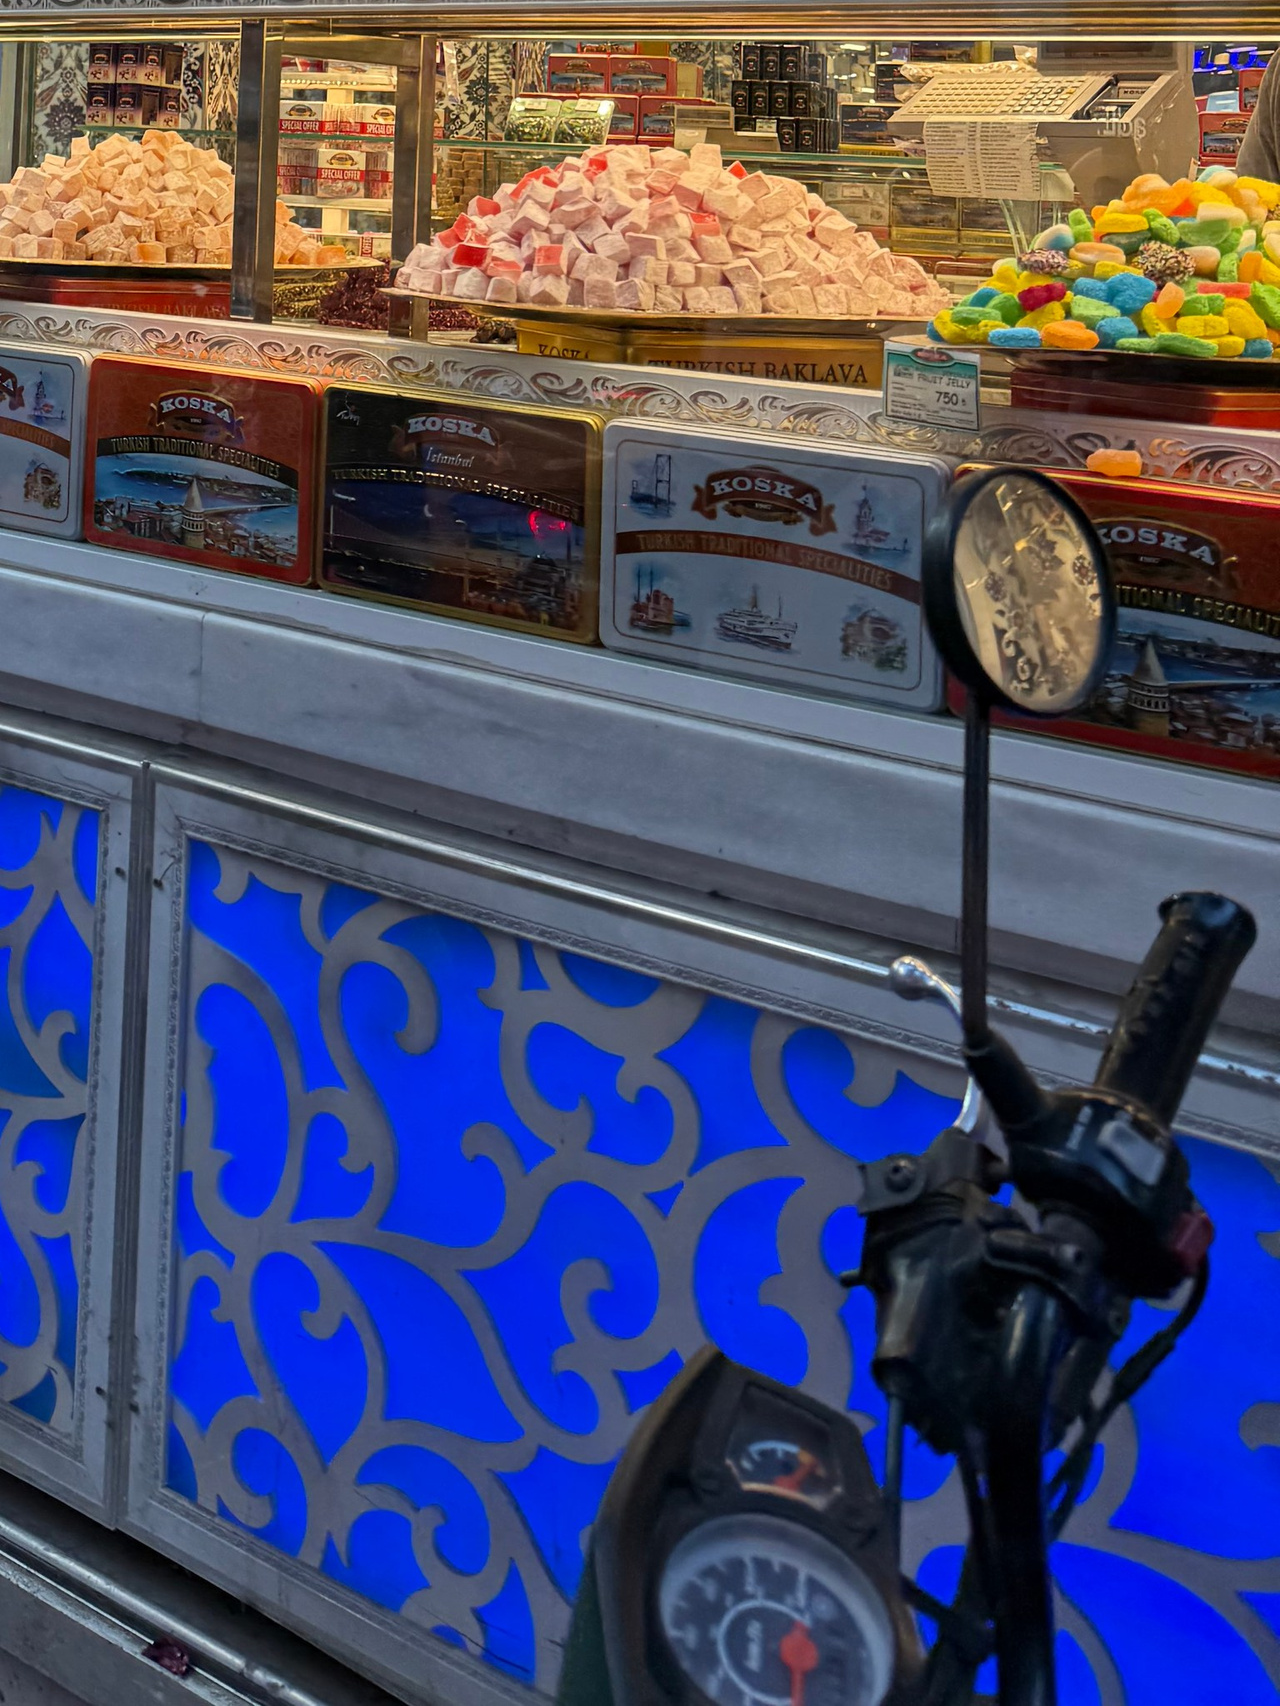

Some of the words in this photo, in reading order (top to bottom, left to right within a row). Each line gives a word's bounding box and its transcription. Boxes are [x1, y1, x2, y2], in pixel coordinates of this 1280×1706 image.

[281, 121, 302, 130] SPECIAL
[302, 122, 320, 131] OFFER
[321, 169, 343, 179] SPECIAL
[343, 170, 360, 179] OFFER
[766, 361, 868, 384] BAKLAVA
[946, 378, 971, 389] JELLY
[160, 396, 231, 423] KOSKA
[935, 391, 958, 406] 750
[408, 416, 496, 446] KOSKA
[111, 437, 150, 453] TURKISH
[152, 437, 214, 459] TRADITIONAL
[218, 446, 280, 478] SPECIALITIES
[332, 469, 387, 481] TURKISH
[391, 469, 482, 493] TRADITIONAL
[485, 482, 580, 519] SPECIALITIES
[711, 476, 818, 511] KOSKA
[636, 534, 694, 550] TURKISH
[701, 535, 794, 562] TRADITIONAL
[799, 550, 892, 589] SPECIALITIES
